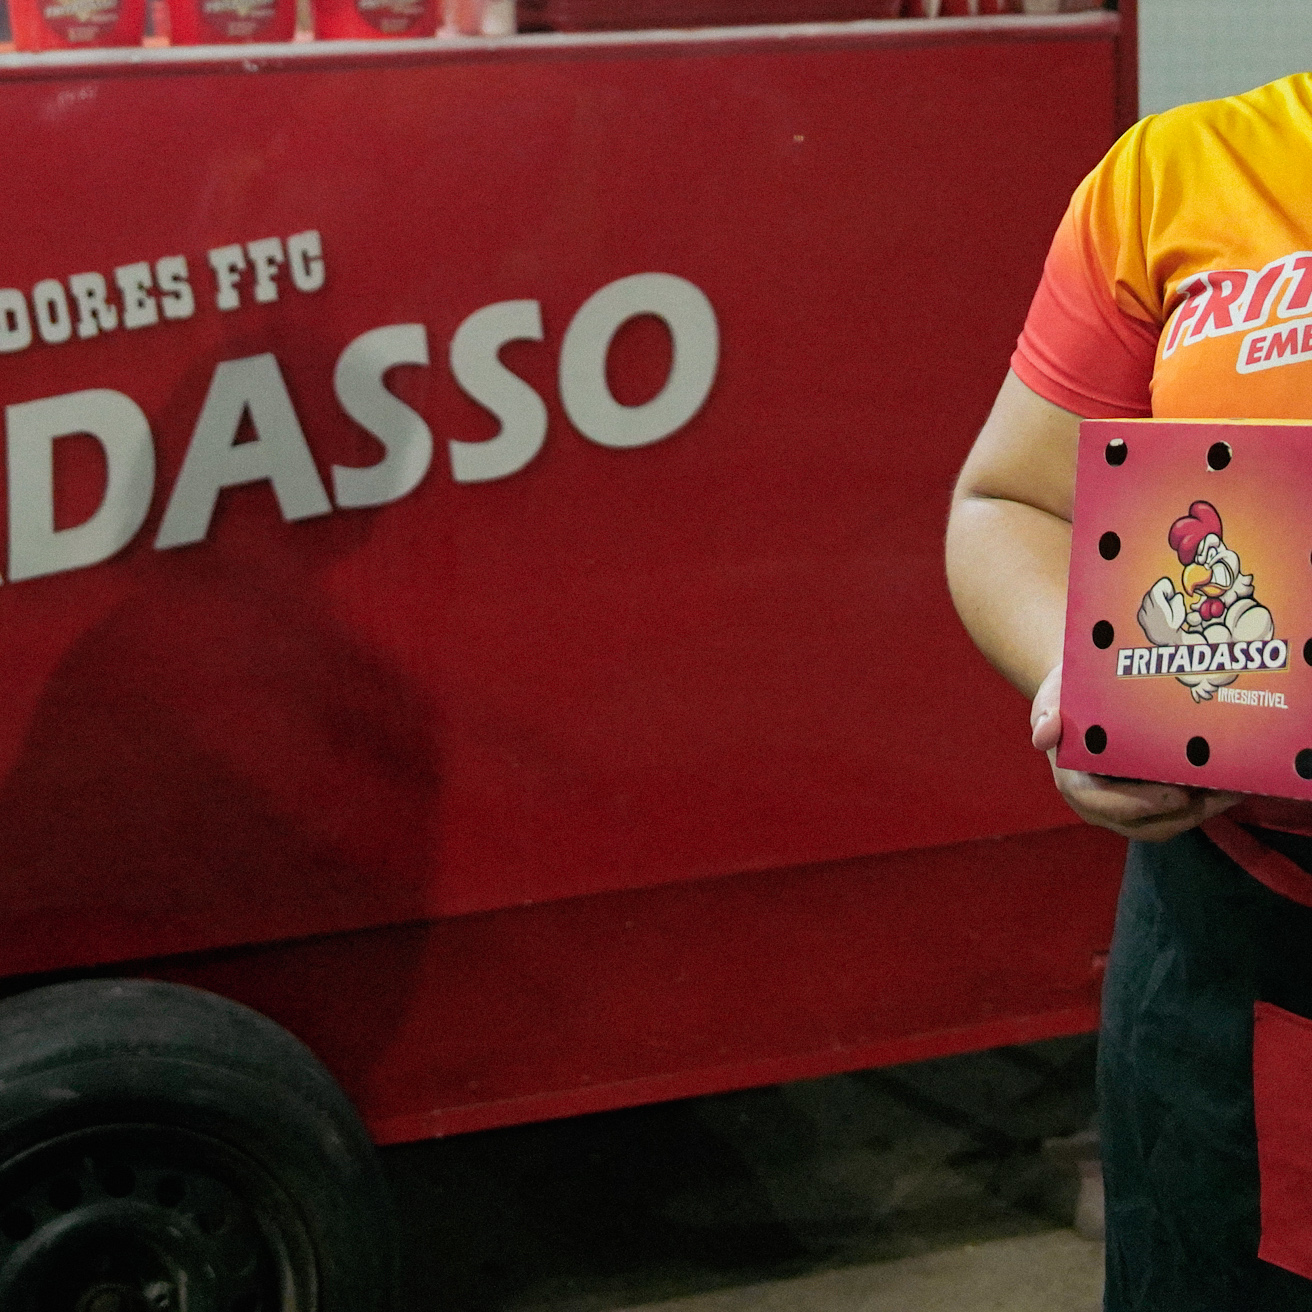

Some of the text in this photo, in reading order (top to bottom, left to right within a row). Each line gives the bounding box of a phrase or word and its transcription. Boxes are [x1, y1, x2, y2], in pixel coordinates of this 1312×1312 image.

[208, 230, 326, 310] FFC
[1116, 639, 1288, 677] FRITADASSO
[1217, 686, 1289, 709] IRRESISTÍVEL
